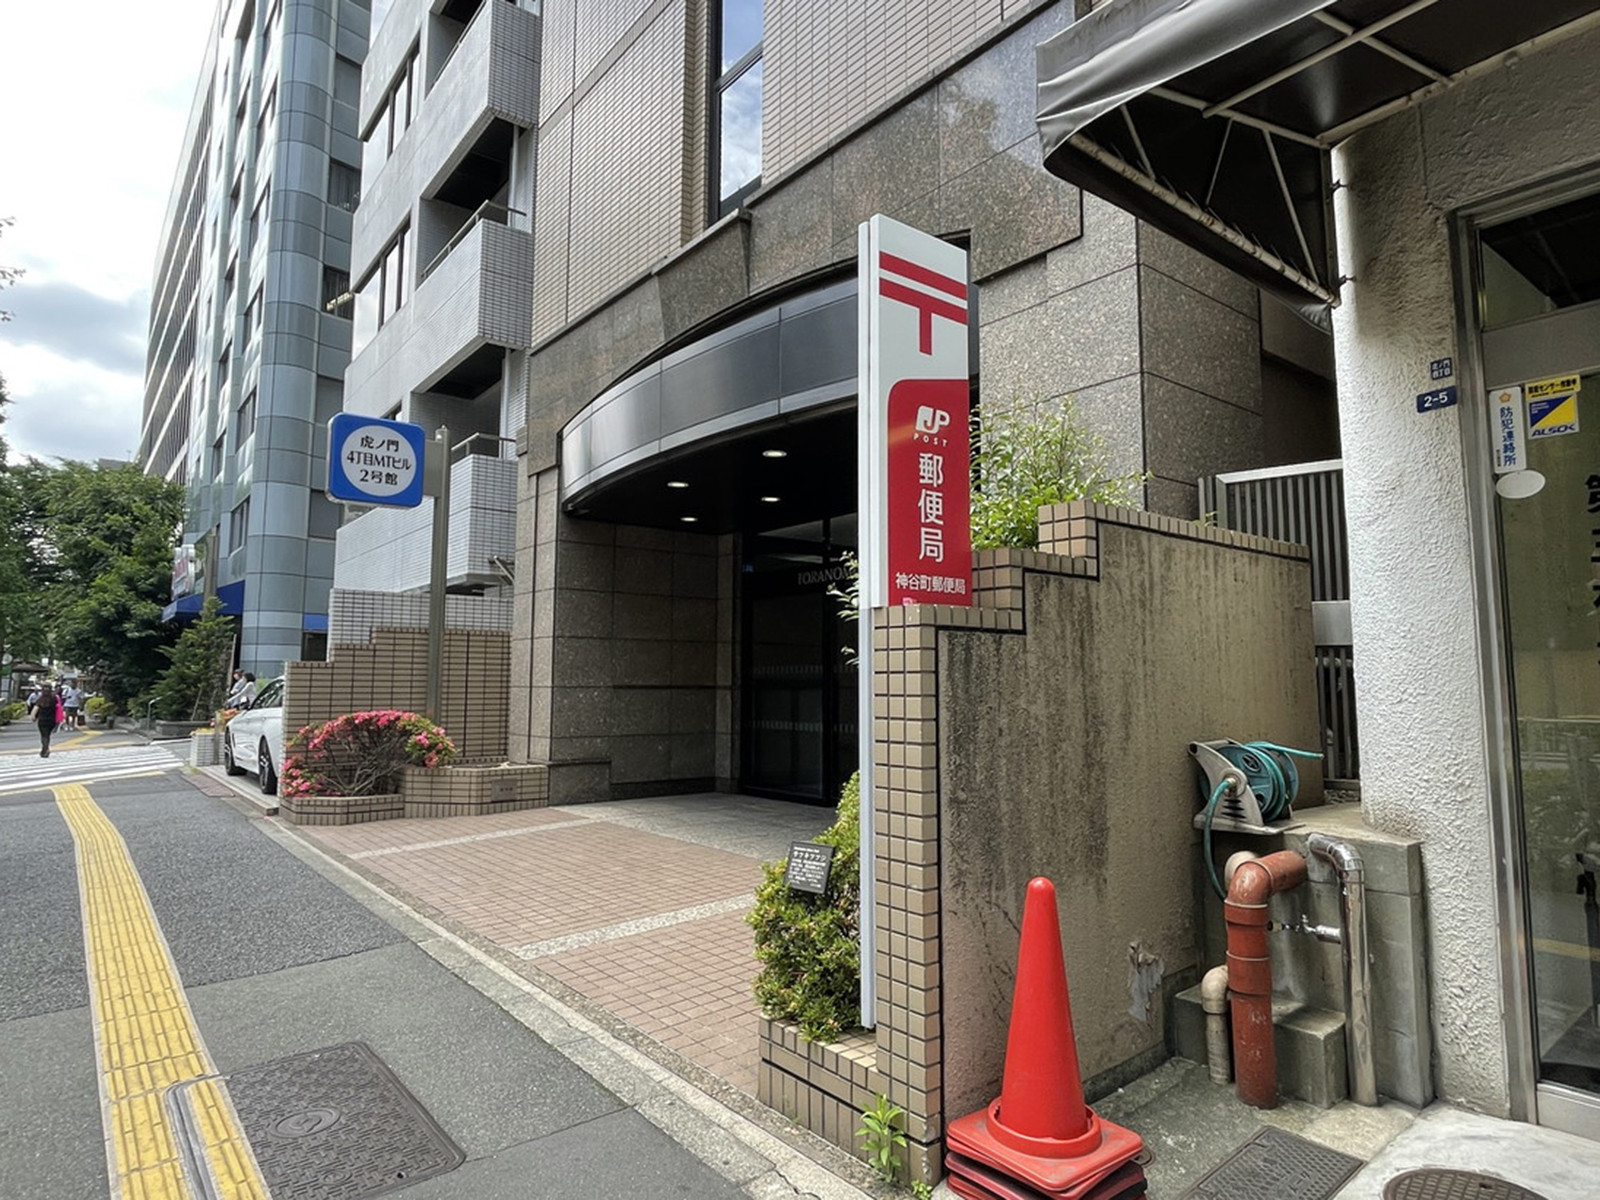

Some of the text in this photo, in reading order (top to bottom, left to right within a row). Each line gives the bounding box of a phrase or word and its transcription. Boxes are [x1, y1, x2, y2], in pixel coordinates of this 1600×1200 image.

[1424, 391, 1448, 407] 2-5
[913, 432, 948, 447] POST
[1500, 406, 1516, 467] 防犯連絡所
[1531, 424, 1576, 437] ALSOK
[360, 434, 399, 452] 虎ノ門
[347, 450, 412, 471] 4丁目MTビル
[359, 469, 398, 486] 2号館
[918, 452, 944, 563] 郵便局
[895, 571, 966, 595] 神谷町郵便局
